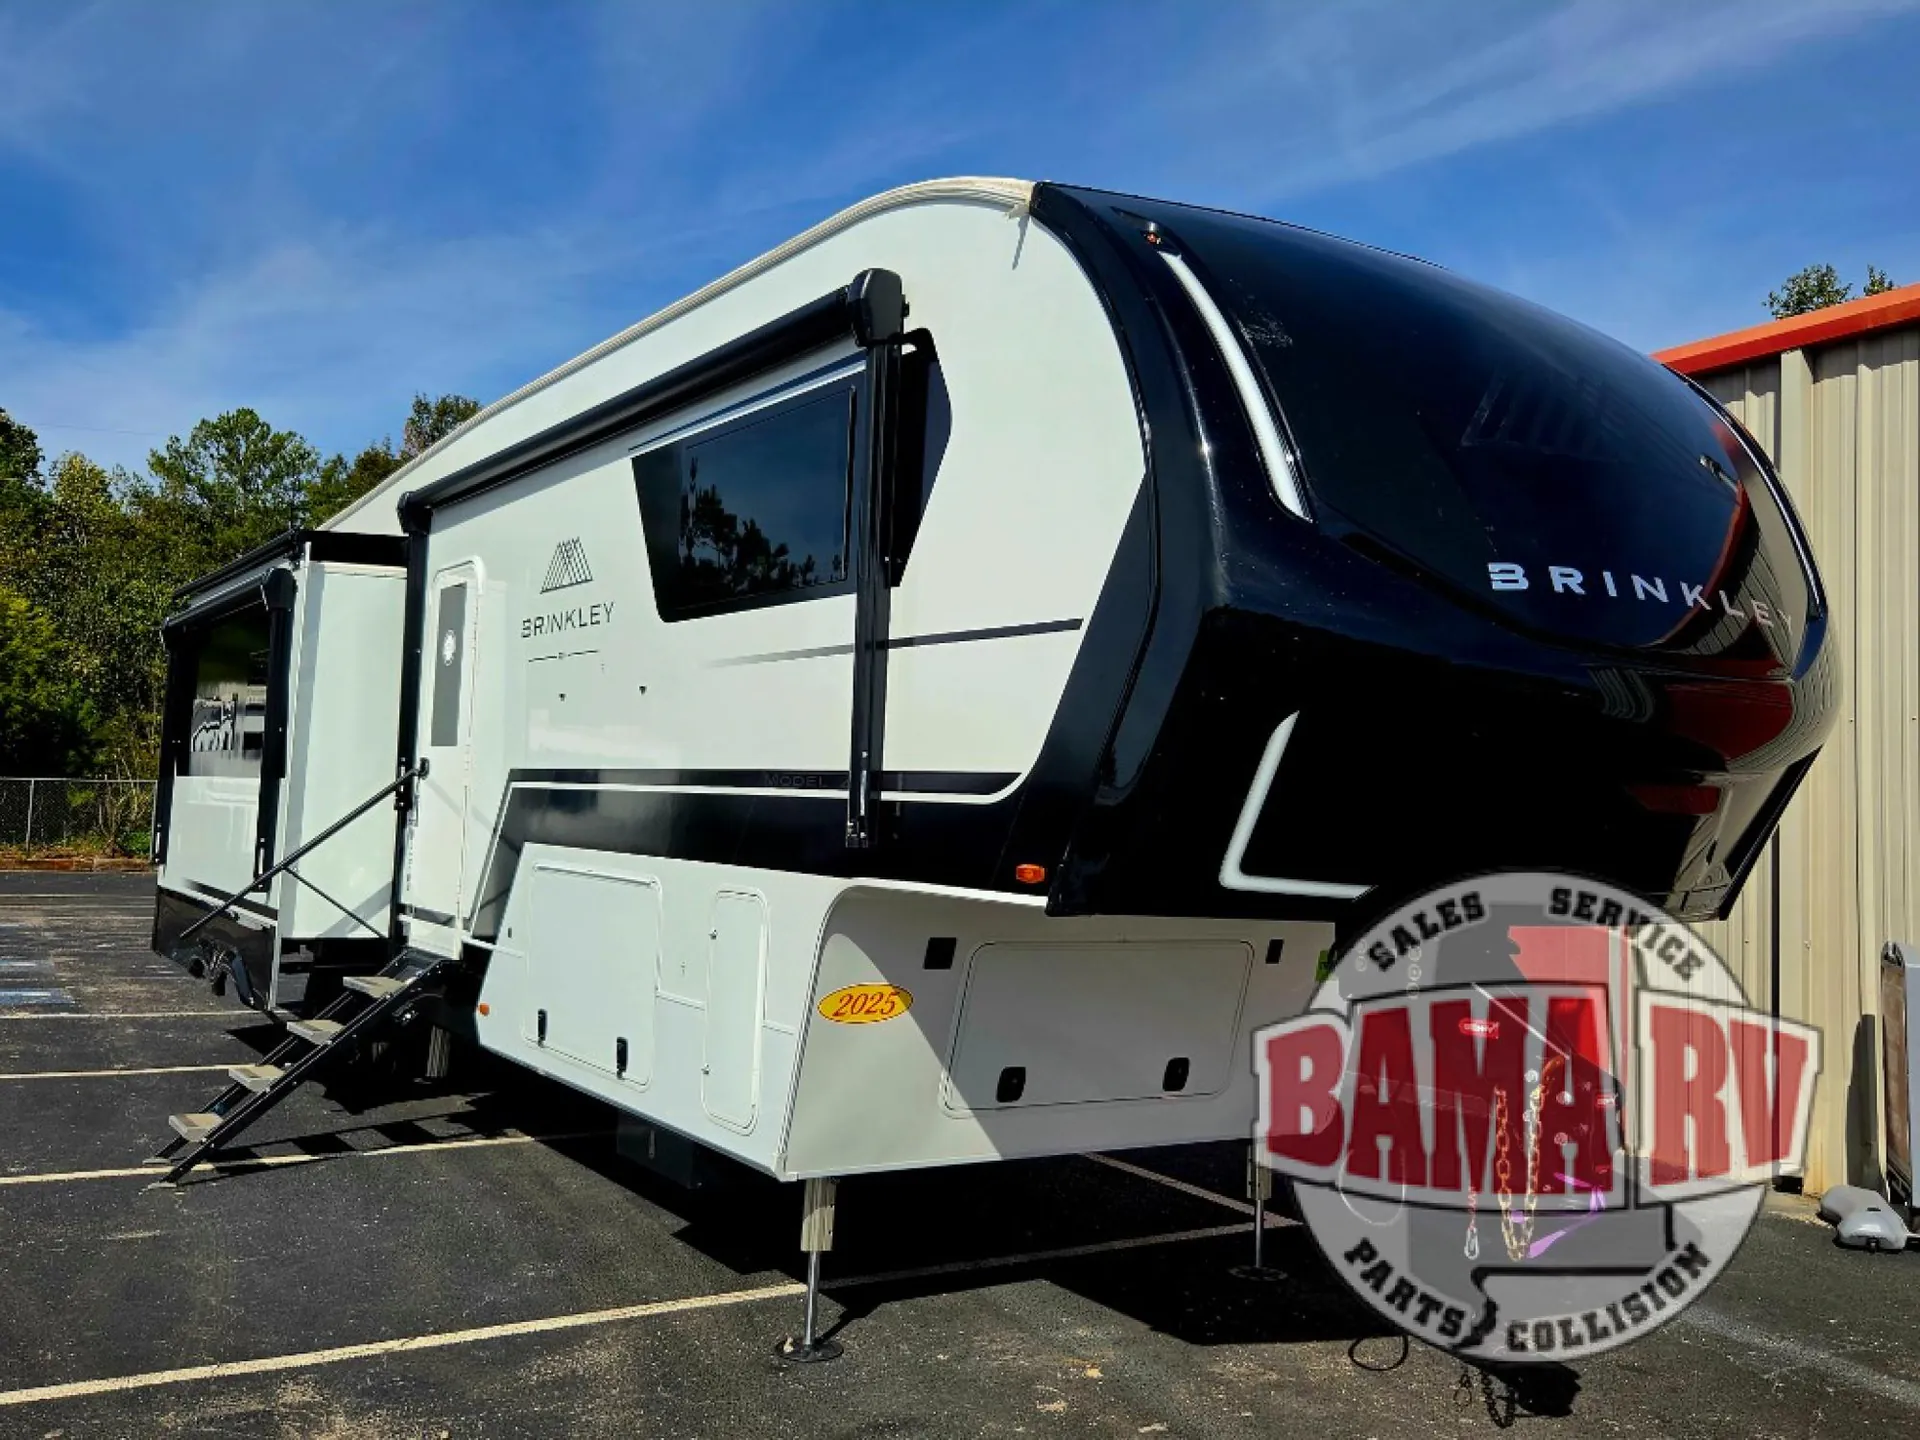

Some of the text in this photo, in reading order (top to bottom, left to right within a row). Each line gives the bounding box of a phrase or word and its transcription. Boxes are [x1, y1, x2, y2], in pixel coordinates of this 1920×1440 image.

[1488, 562, 1792, 636] BRINKLEY
[521, 601, 615, 638] BRINKLEY
[764, 772, 828, 789] MODEL
[832, 989, 901, 1017] 2025
